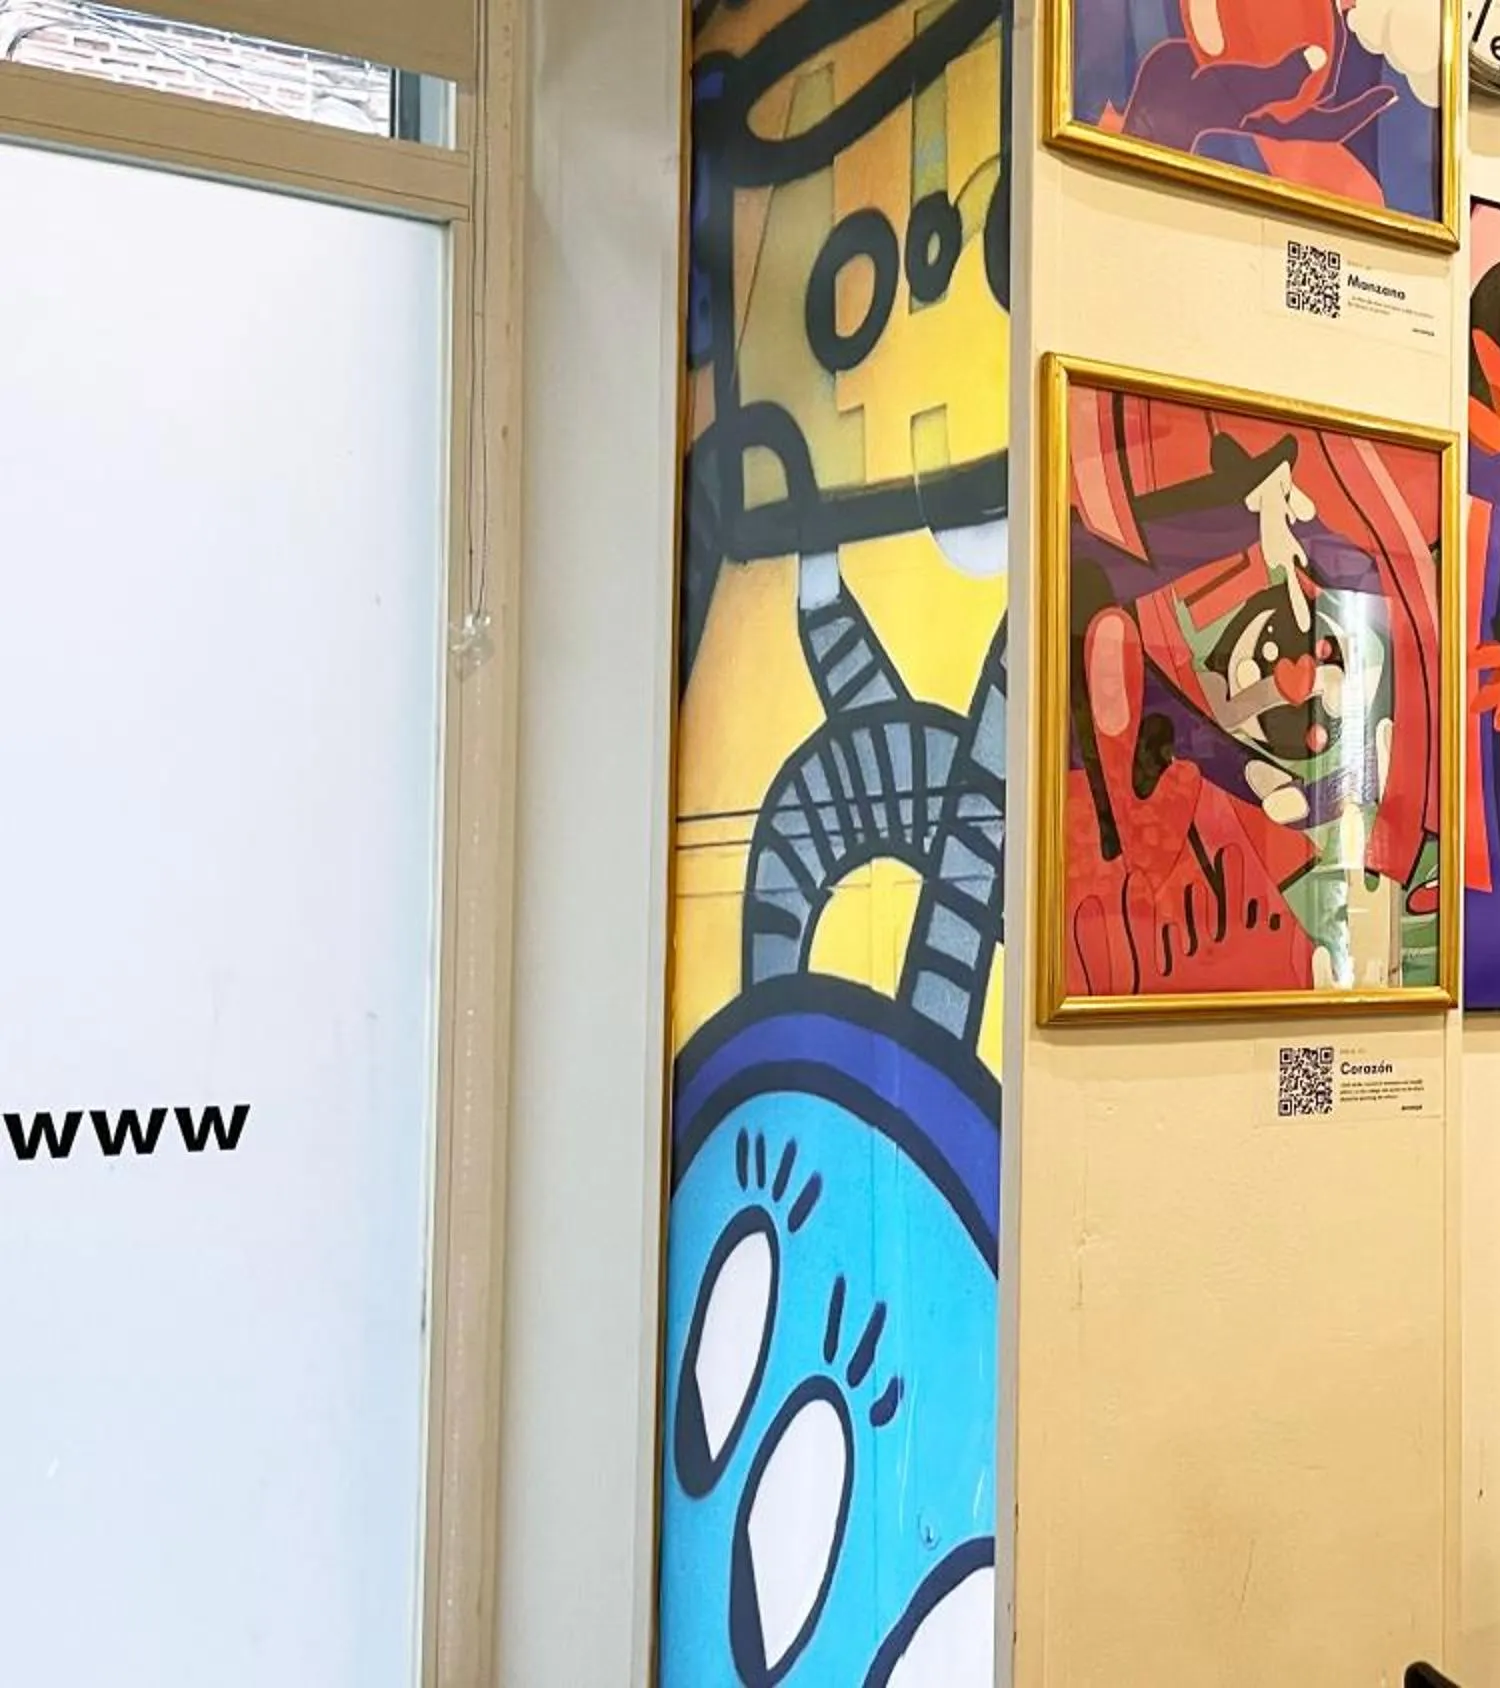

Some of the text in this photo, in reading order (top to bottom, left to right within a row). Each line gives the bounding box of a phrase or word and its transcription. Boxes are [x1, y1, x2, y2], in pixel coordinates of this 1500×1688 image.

[1347, 273, 1406, 300] Manzana
[1340, 1060, 1393, 1075] Corazón
[2, 1103, 251, 1161] www
